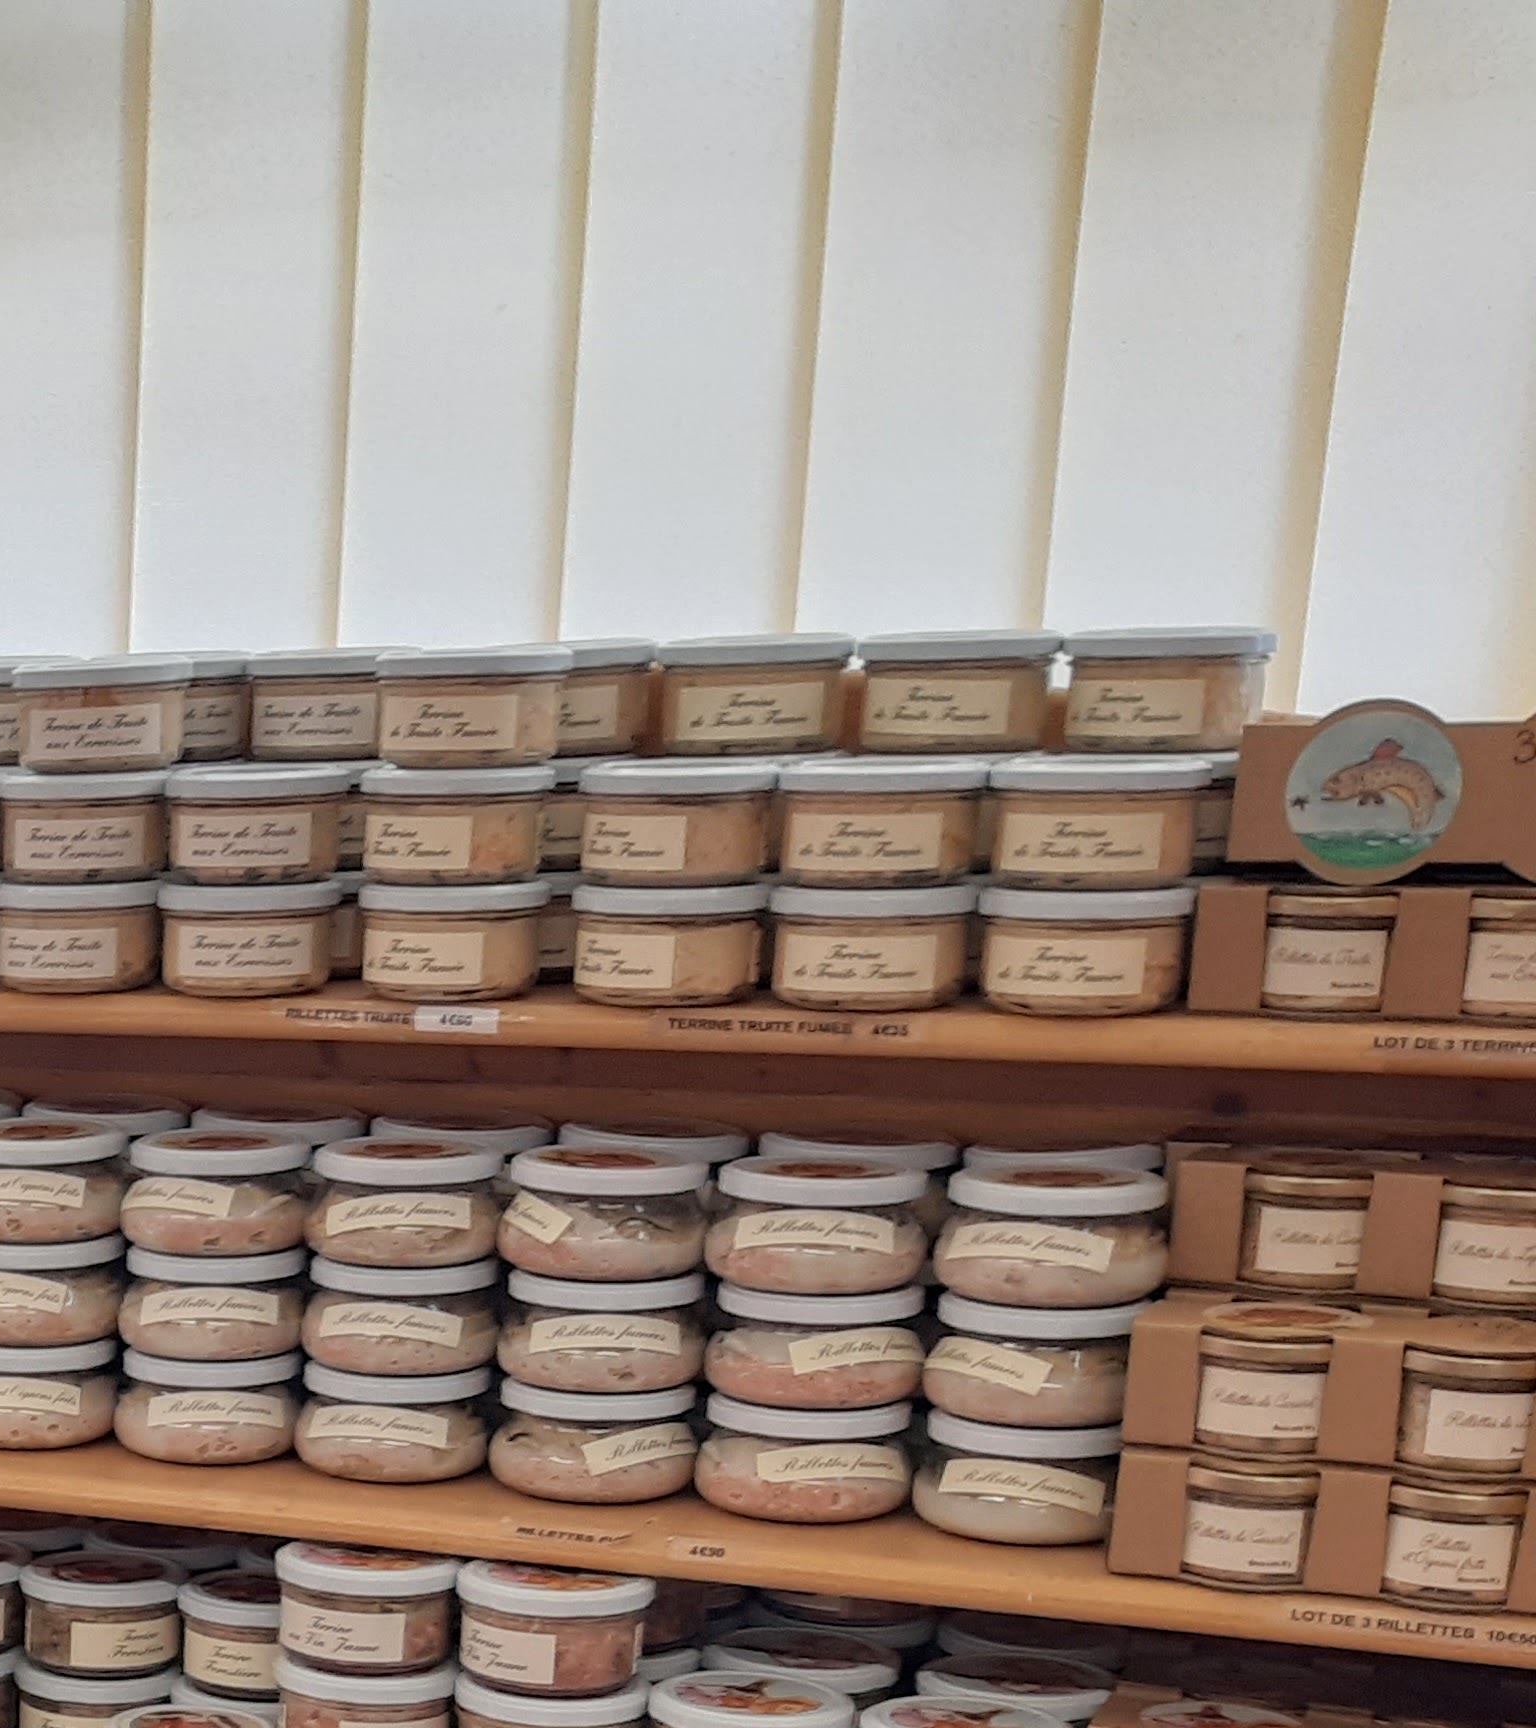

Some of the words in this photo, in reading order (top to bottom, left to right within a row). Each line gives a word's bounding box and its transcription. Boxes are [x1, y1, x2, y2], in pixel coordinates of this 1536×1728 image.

[285, 1008, 358, 1023] RILLETTES
[668, 1018, 733, 1032] TERRINE
[738, 1019, 793, 1033] TRUITE
[1374, 1036, 1407, 1049] LOT
[1415, 1037, 1439, 1050] DE
[1443, 1039, 1455, 1050] 3
[516, 1527, 594, 1543] RILLETTES
[1290, 1608, 1327, 1625] LOT
[1331, 1612, 1355, 1627] DE
[1362, 1616, 1371, 1629] 3
[1377, 1617, 1475, 1640] RILLETTES
